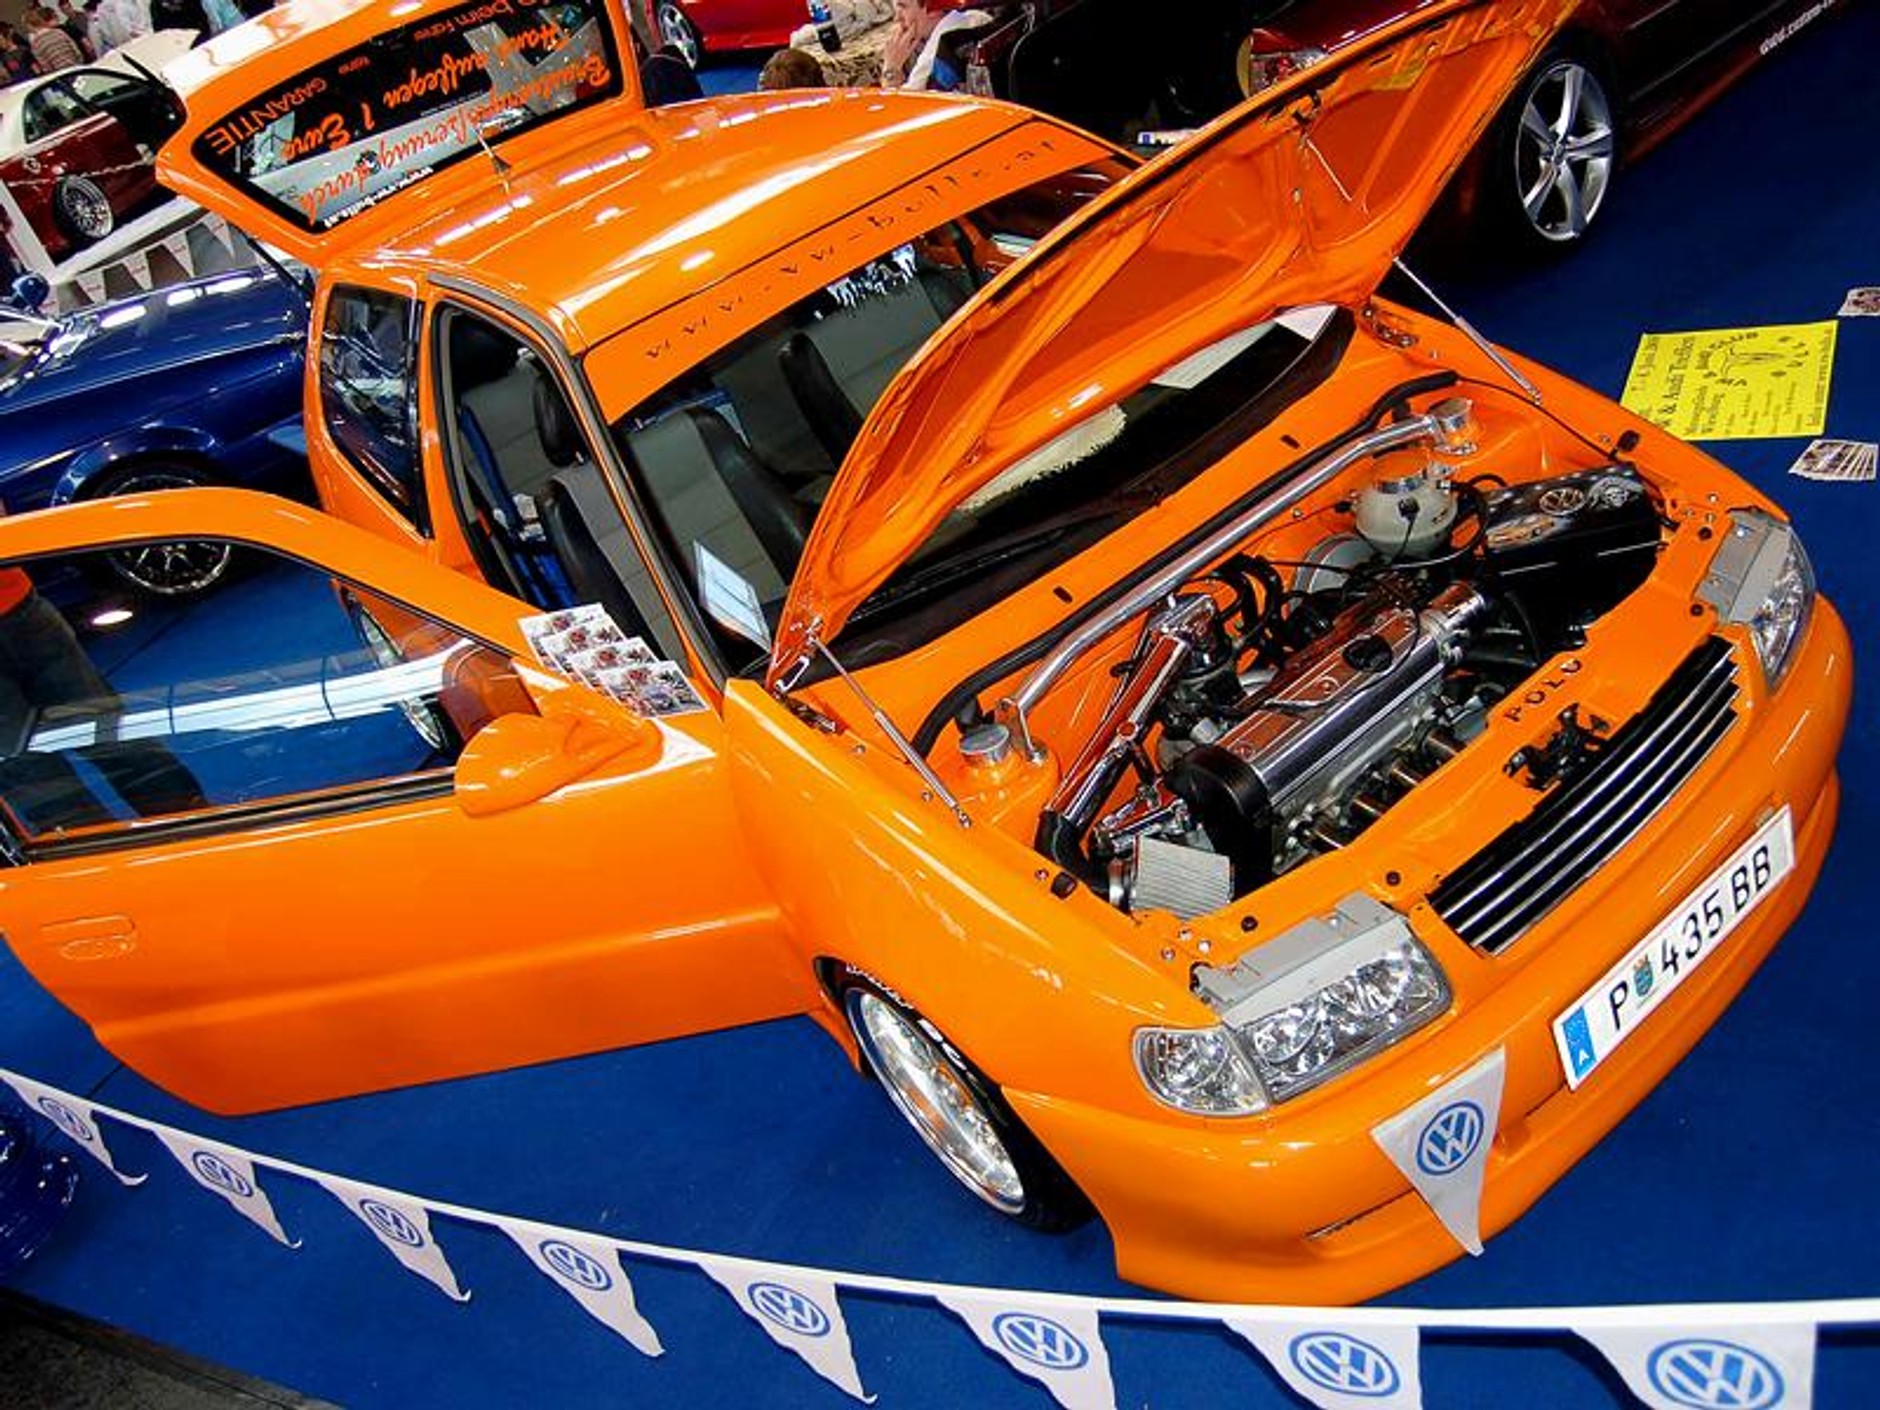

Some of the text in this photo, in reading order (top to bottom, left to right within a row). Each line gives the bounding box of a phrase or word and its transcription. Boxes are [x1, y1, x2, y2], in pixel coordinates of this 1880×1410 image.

[205, 77, 327, 155] GARANTIE
[281, 112, 350, 159] Euro
[361, 102, 376, 130] 1
[299, 160, 376, 227] durch
[1502, 658, 1582, 723] POLO
[1609, 980, 1628, 1031] P
[1661, 889, 1724, 977] 435
[1731, 846, 1771, 913] BB
[1417, 1102, 1483, 1175] VW
[1290, 1332, 1399, 1397] VW
[1648, 1339, 1784, 1410] VW
